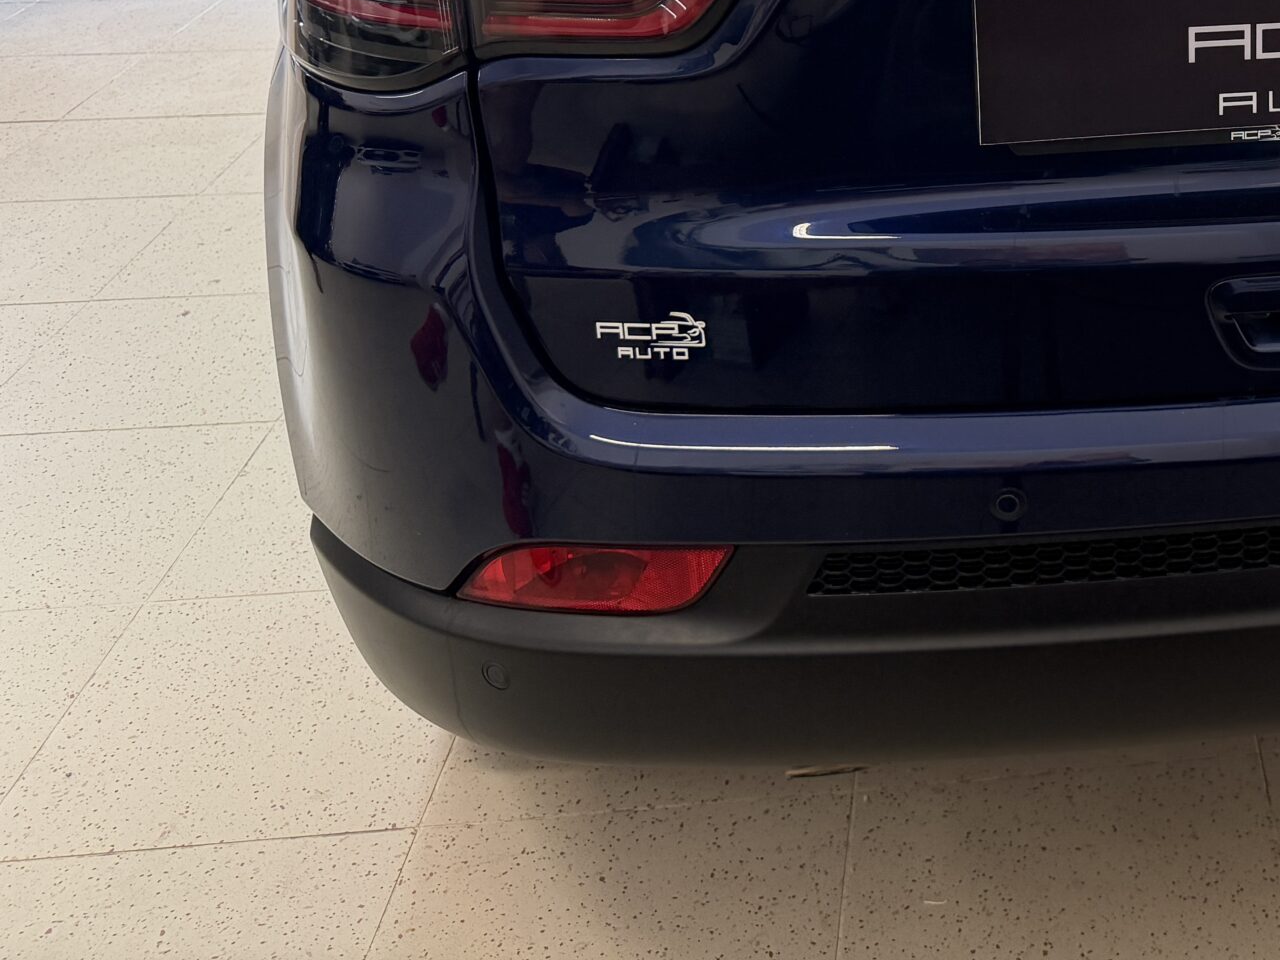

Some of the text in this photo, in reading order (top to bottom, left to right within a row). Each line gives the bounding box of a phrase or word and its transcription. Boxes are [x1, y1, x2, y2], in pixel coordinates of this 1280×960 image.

[1231, 129, 1271, 141] ACP
[596, 321, 680, 340] ACP
[617, 346, 690, 361] AUTO
